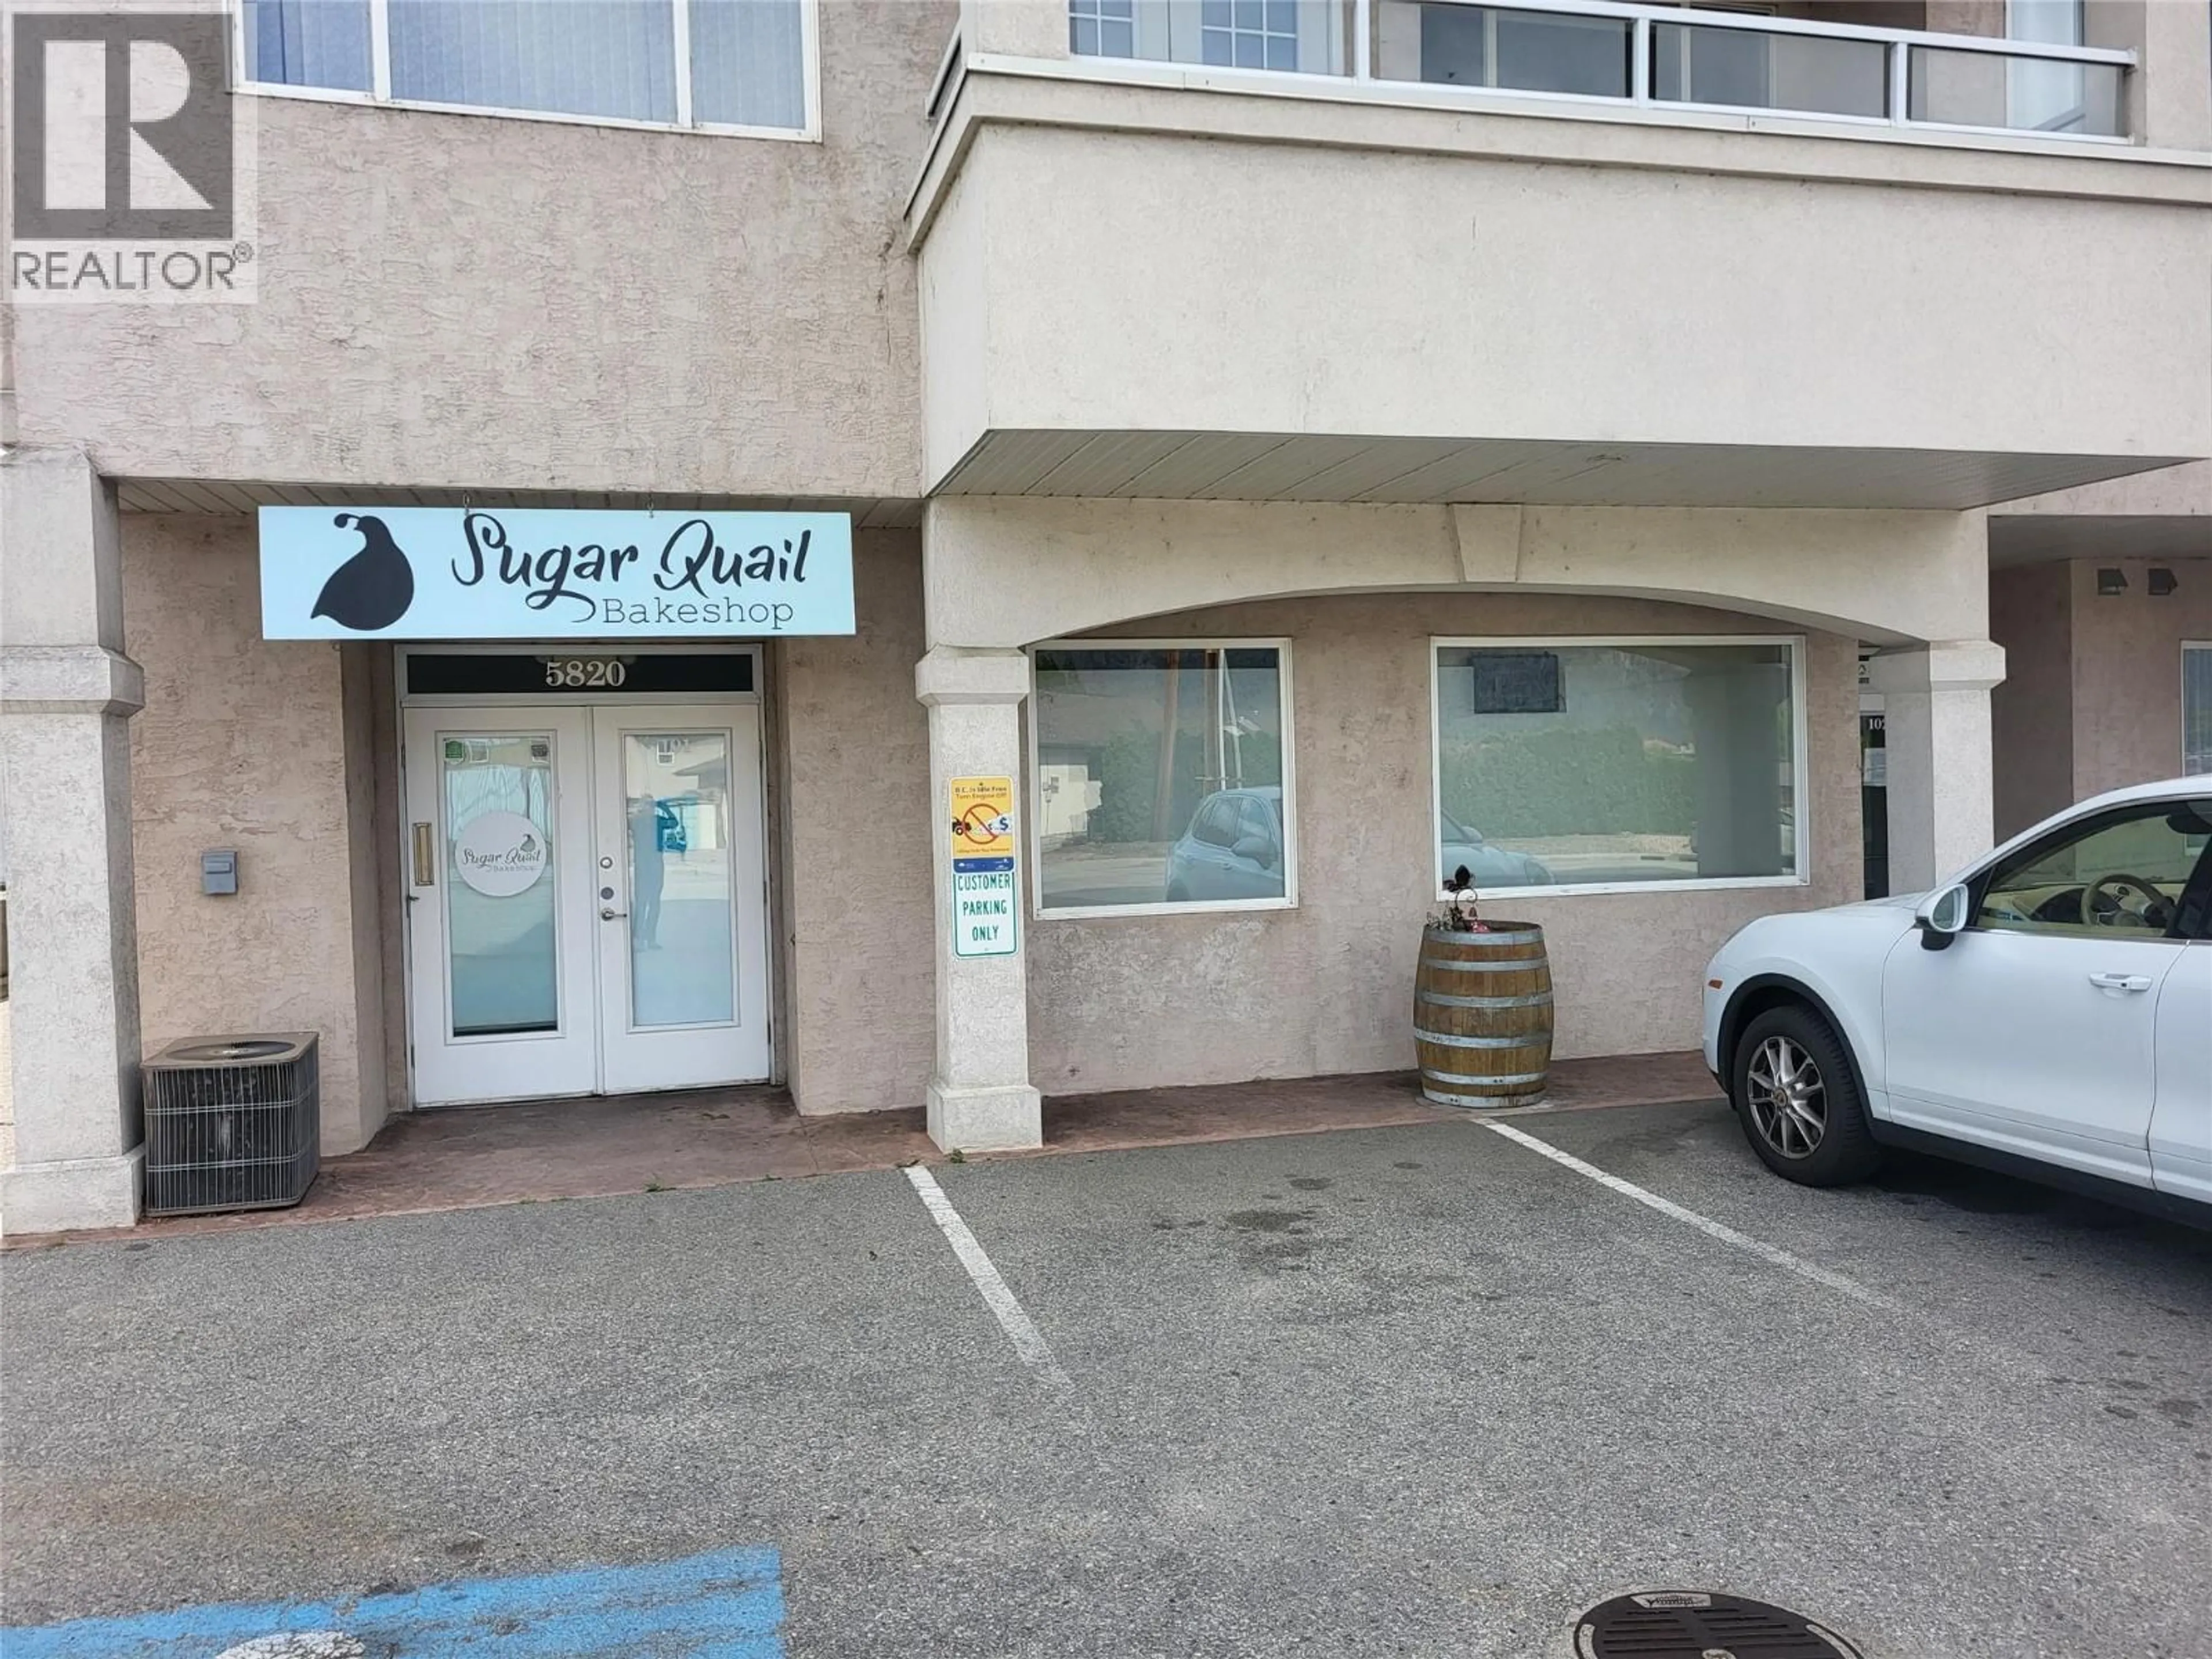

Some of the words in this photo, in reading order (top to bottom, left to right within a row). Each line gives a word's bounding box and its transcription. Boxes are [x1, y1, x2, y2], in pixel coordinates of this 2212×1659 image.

[452, 513, 638, 623] Sugar
[653, 519, 811, 599] Quail
[603, 597, 793, 630] Bakeshop
[546, 661, 626, 687] 5820
[463, 847, 502, 871] Sugar
[504, 847, 541, 865] Quail
[958, 873, 1010, 891] CUSTOMER
[963, 900, 1007, 916] PARKING
[972, 925, 999, 941] ONLY
